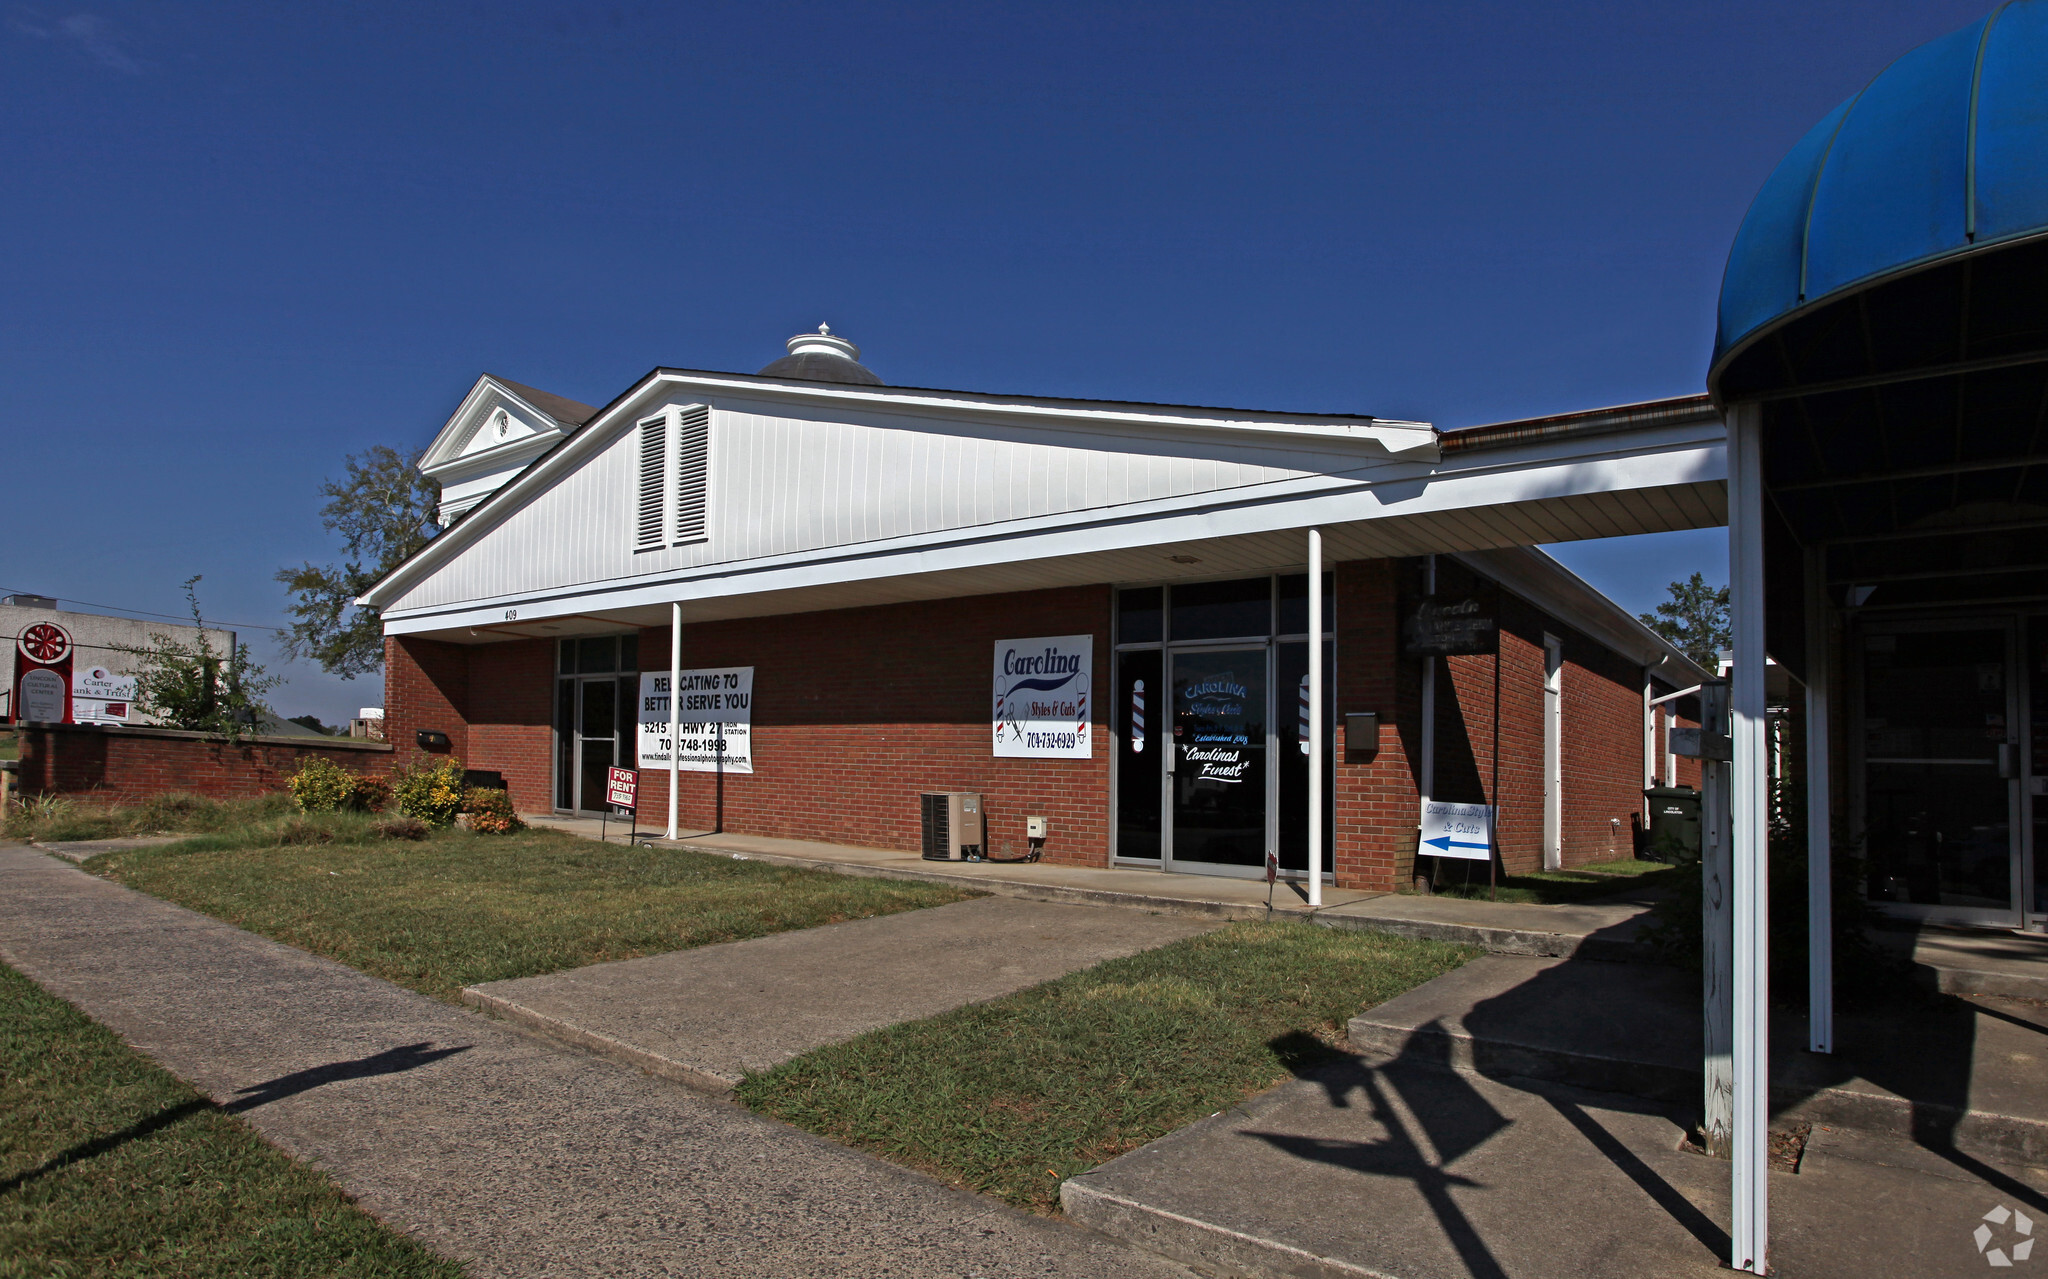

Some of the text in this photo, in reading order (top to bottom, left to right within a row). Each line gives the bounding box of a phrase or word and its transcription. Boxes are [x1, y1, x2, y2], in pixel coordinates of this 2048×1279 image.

[505, 609, 517, 620] 409
[1004, 647, 1081, 675] Carolina
[83, 678, 113, 687] Carter
[653, 673, 738, 692] RELCATING TO
[104, 688, 131, 698] Trust
[1185, 682, 1247, 699] CAROLINA
[644, 692, 749, 711] BETTR SERVE YOU
[1031, 700, 1076, 718] Styles & Cuts
[644, 722, 667, 734] 5215
[682, 722, 706, 734] HWY
[709, 722, 721, 734] 27
[659, 738, 727, 751] 70-748-1998
[1194, 734, 1232, 743] Established
[613, 770, 633, 782] FOR
[610, 780, 636, 793] RENT
[1426, 803, 1492, 819] Carolina Style
[1443, 821, 1480, 834] & Cuts
